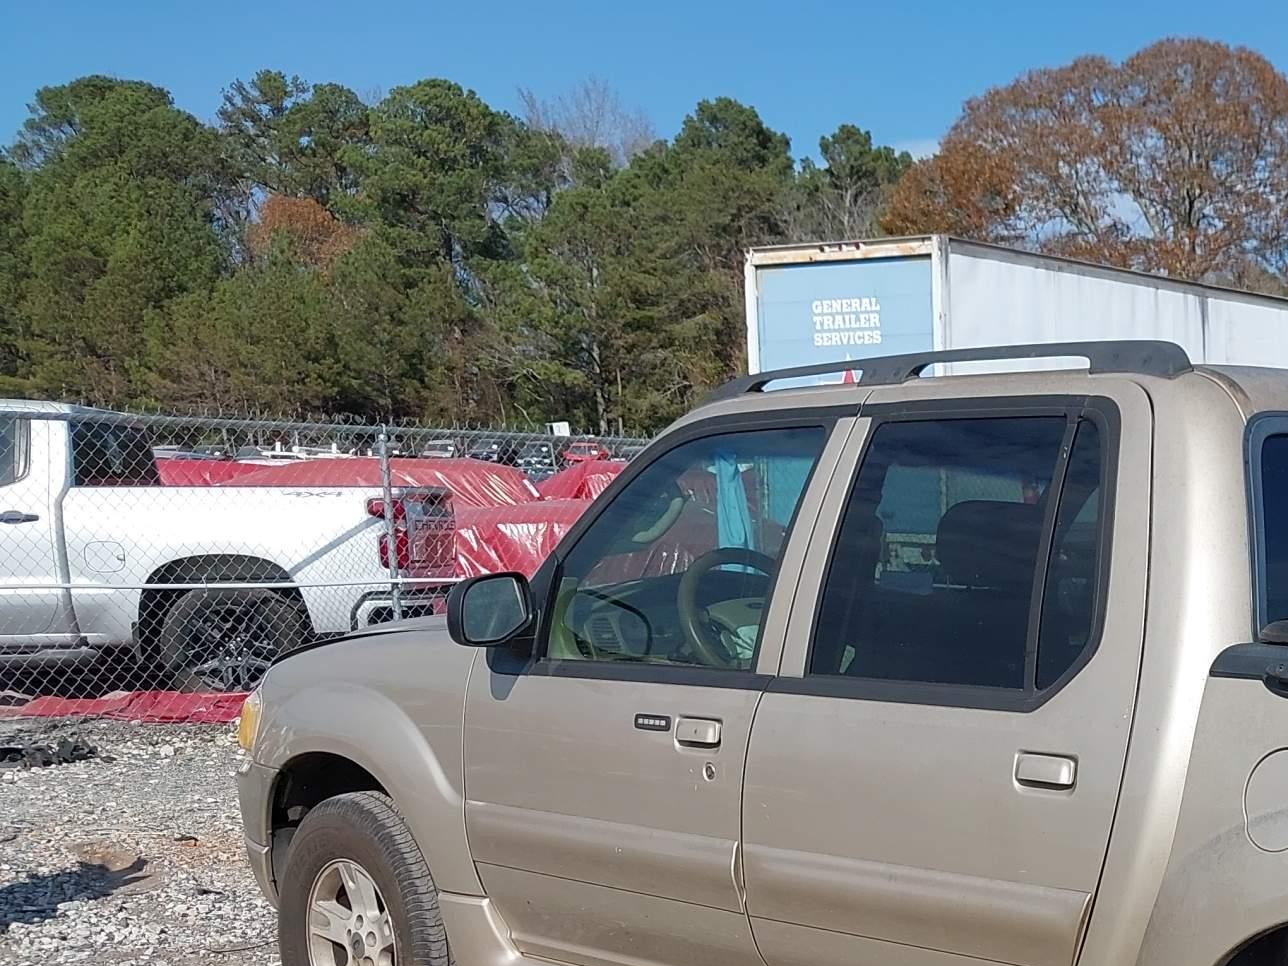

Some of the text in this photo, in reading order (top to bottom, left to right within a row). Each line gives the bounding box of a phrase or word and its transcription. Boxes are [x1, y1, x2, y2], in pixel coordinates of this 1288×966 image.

[812, 297, 880, 314] GENERAL
[812, 312, 880, 330] TRAILER
[814, 330, 882, 346] SERVICES
